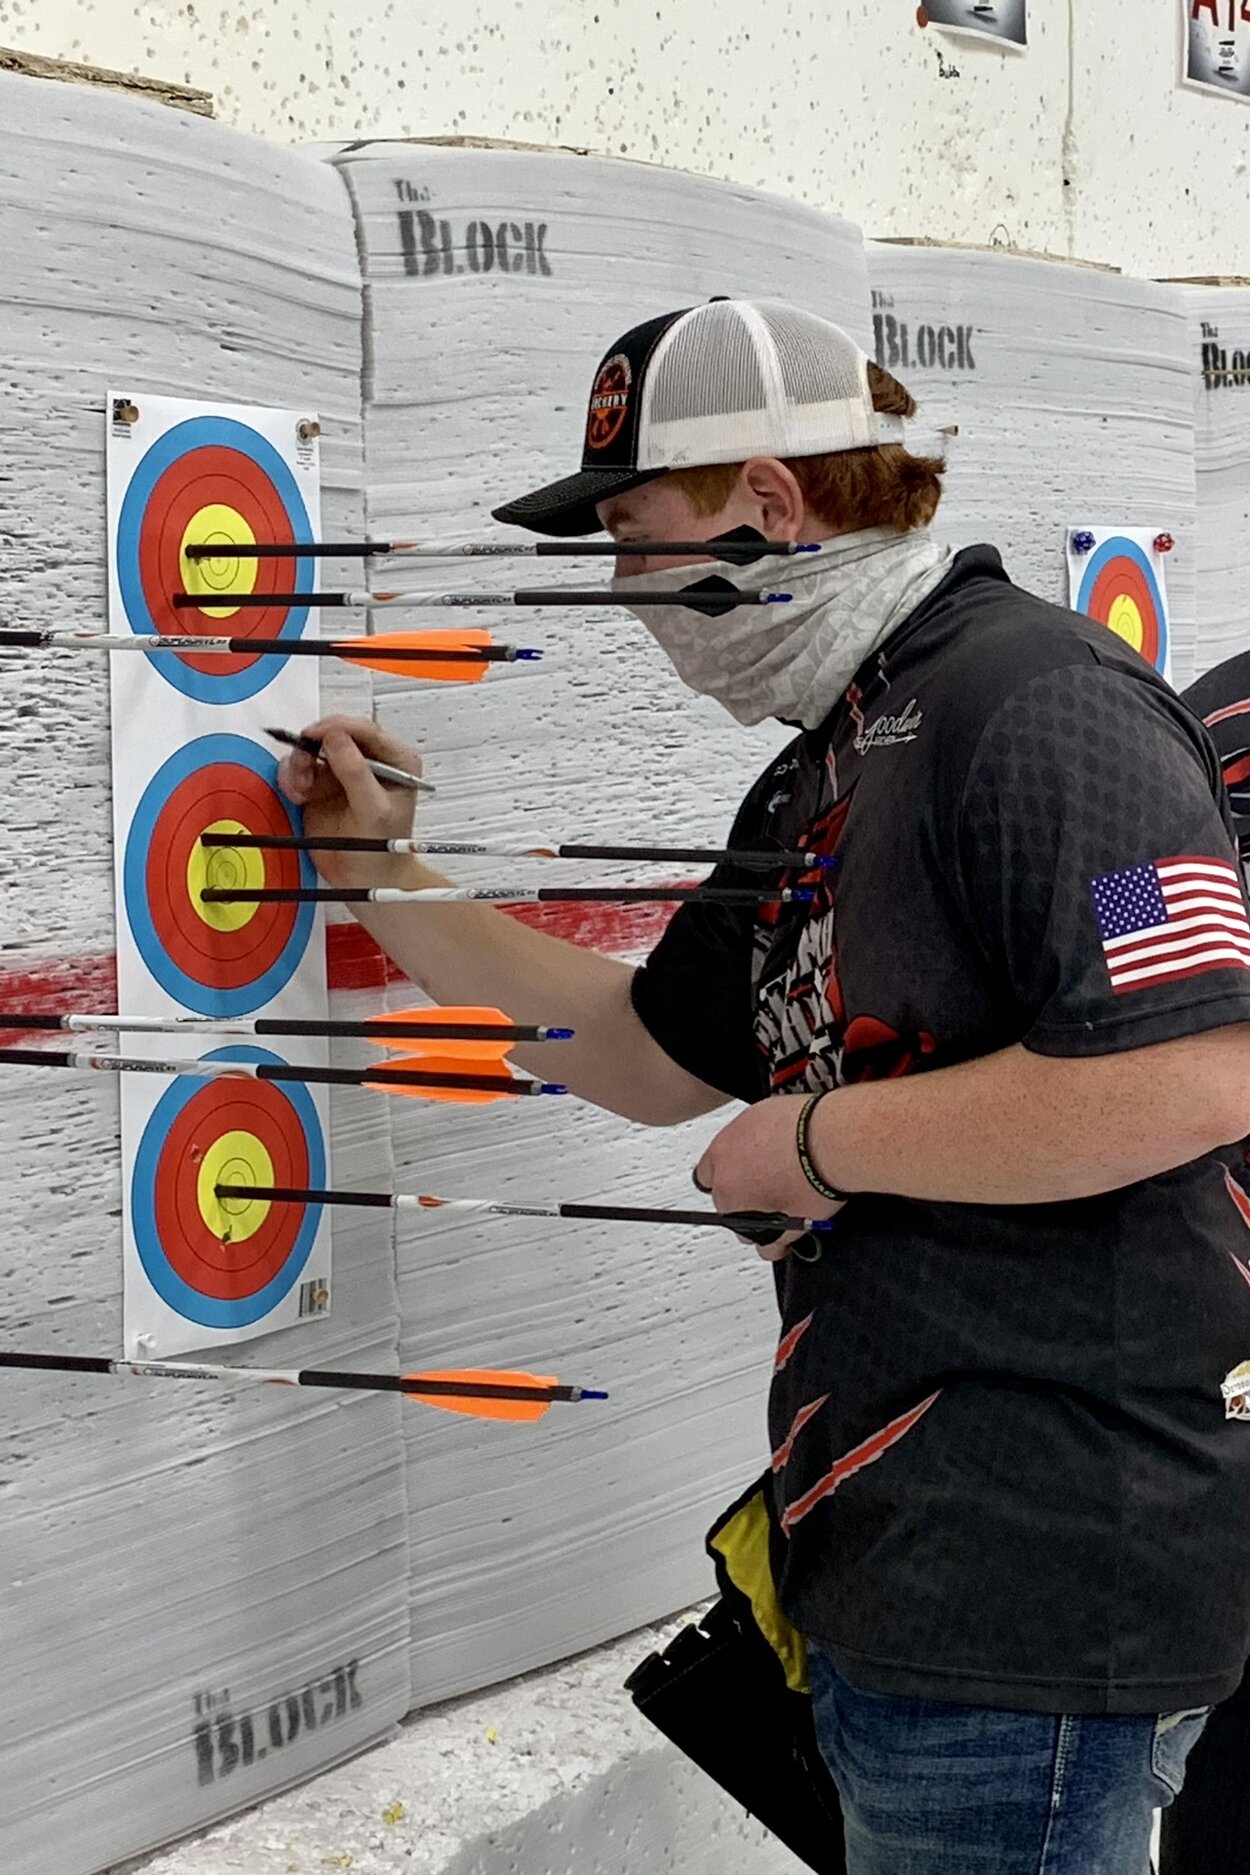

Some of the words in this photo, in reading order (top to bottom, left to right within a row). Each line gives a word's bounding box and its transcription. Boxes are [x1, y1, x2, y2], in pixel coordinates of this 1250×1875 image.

[398, 210, 555, 276] BLOCK
[872, 313, 976, 371] BLOCK
[194, 1658, 363, 1787] BLOCK
